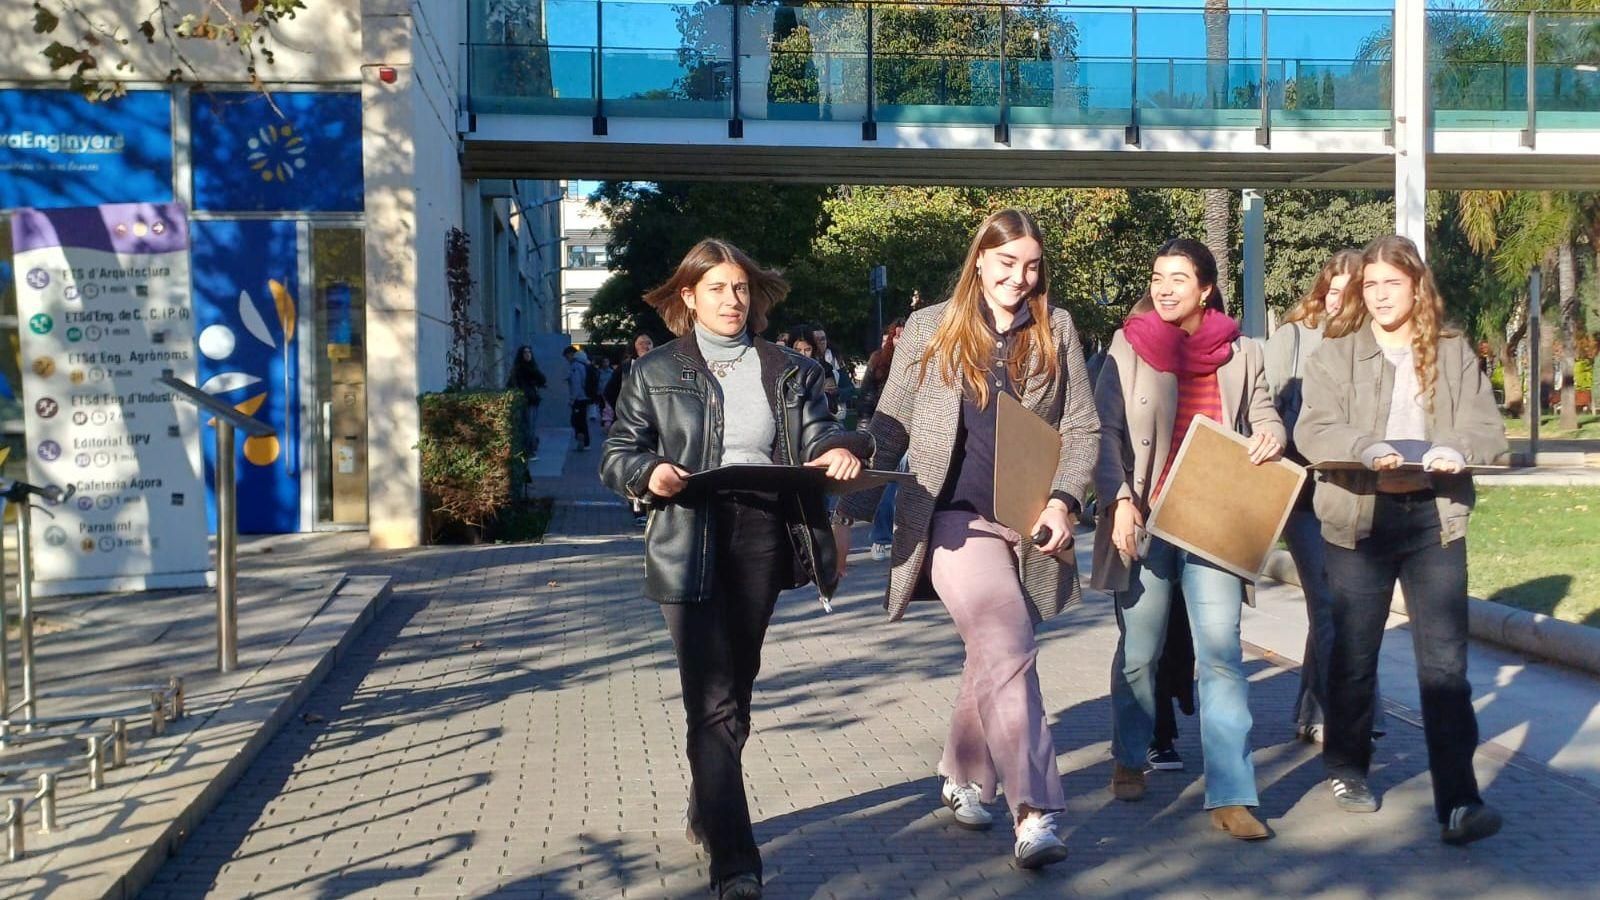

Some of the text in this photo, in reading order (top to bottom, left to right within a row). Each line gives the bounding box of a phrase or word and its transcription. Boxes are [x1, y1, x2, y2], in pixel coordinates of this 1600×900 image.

[63, 267, 85, 280] ETS
[74, 433, 151, 450] Editorial UPV
